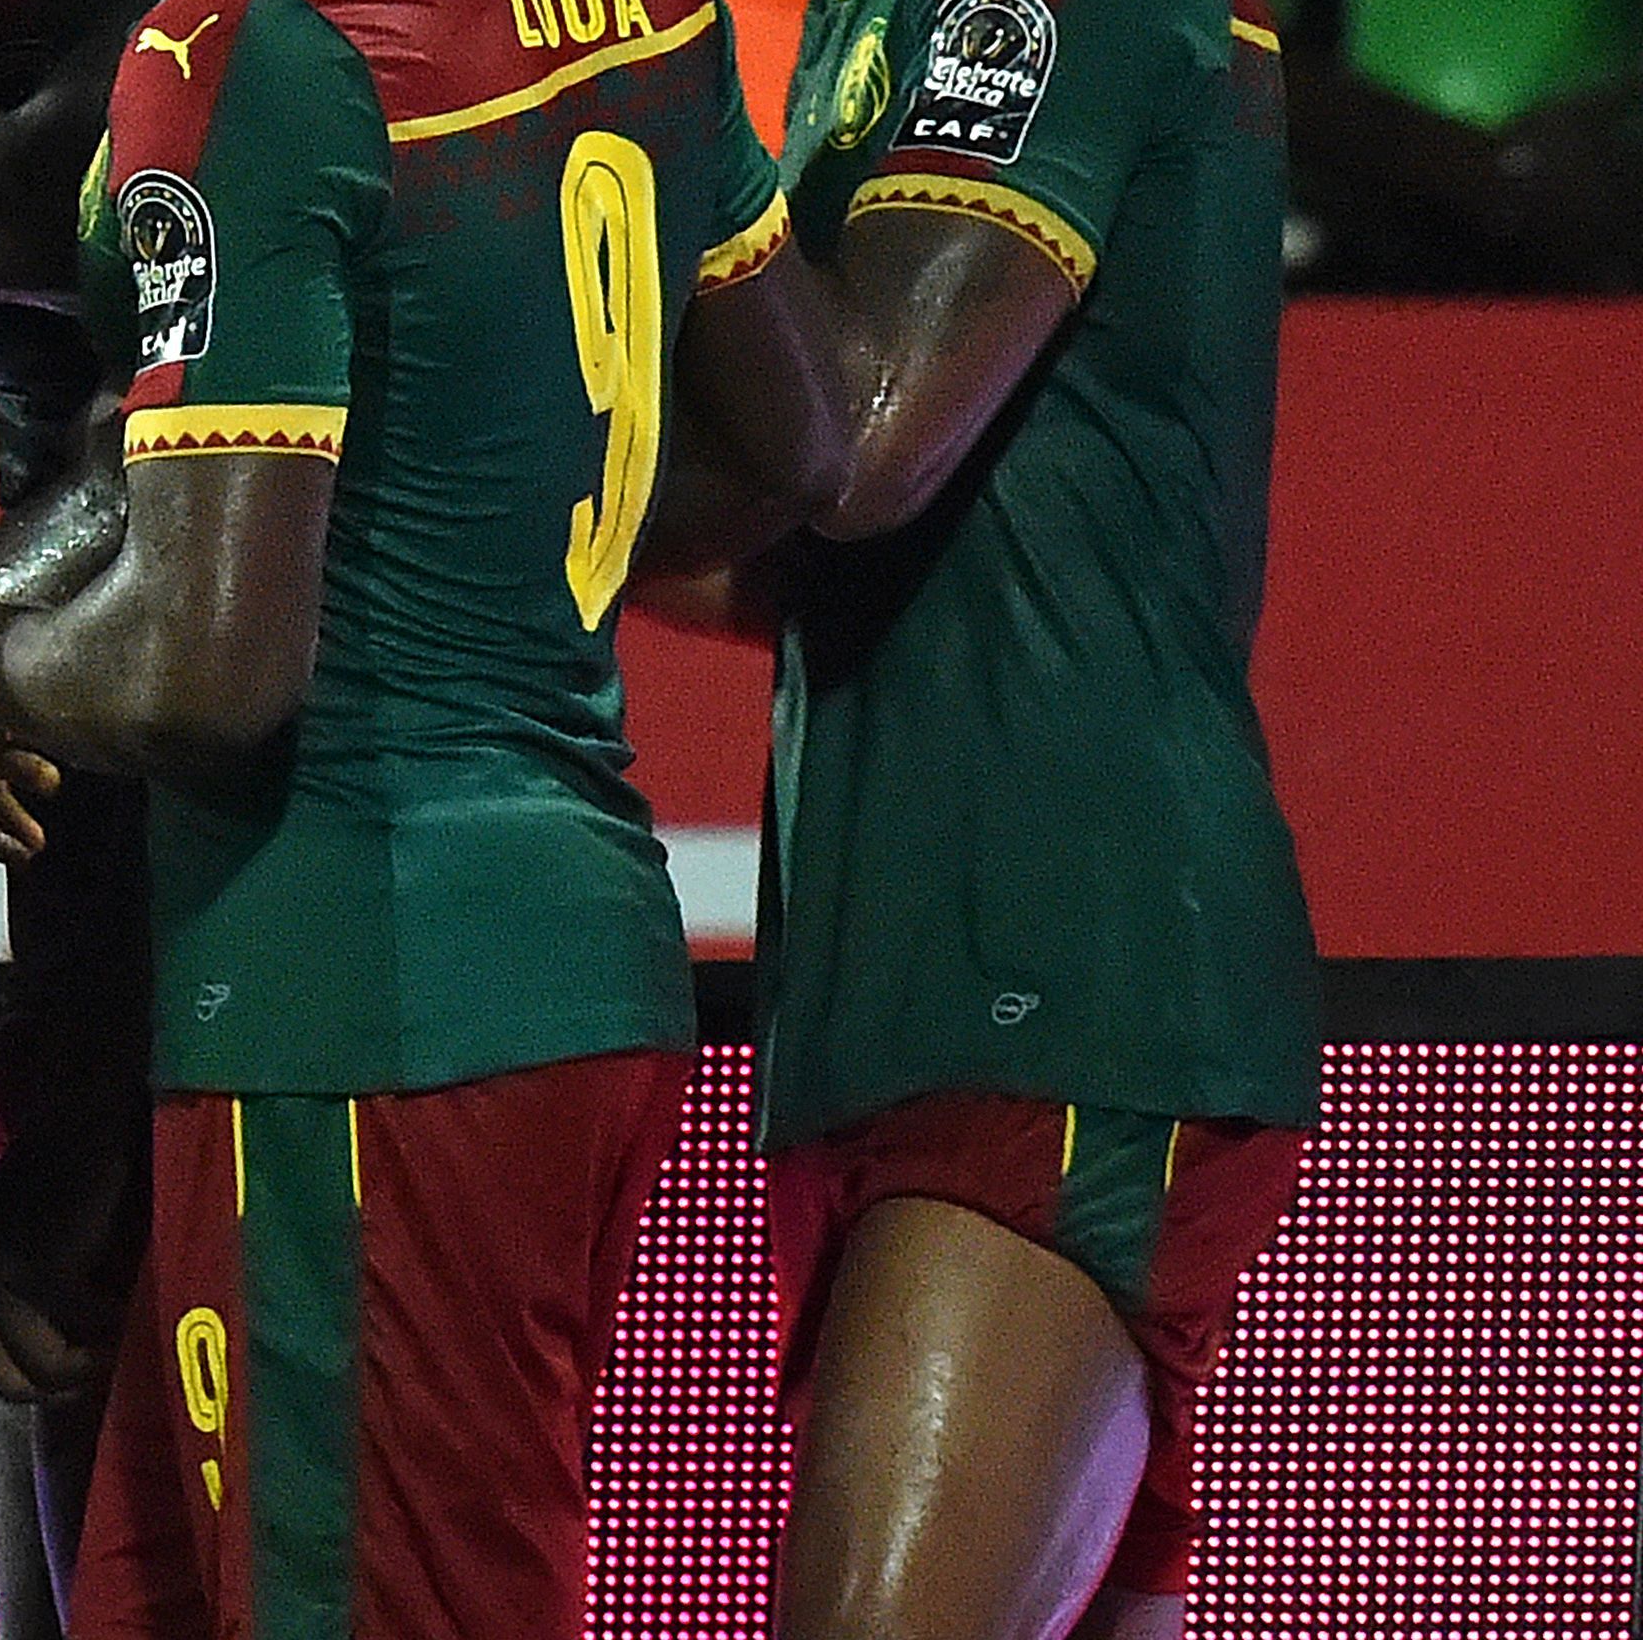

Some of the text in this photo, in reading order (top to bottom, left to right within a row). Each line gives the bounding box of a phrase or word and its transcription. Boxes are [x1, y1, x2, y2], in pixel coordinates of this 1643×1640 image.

[914, 118, 995, 142] CAF
[561, 131, 661, 631] 9
[176, 1307, 227, 1510] 9
